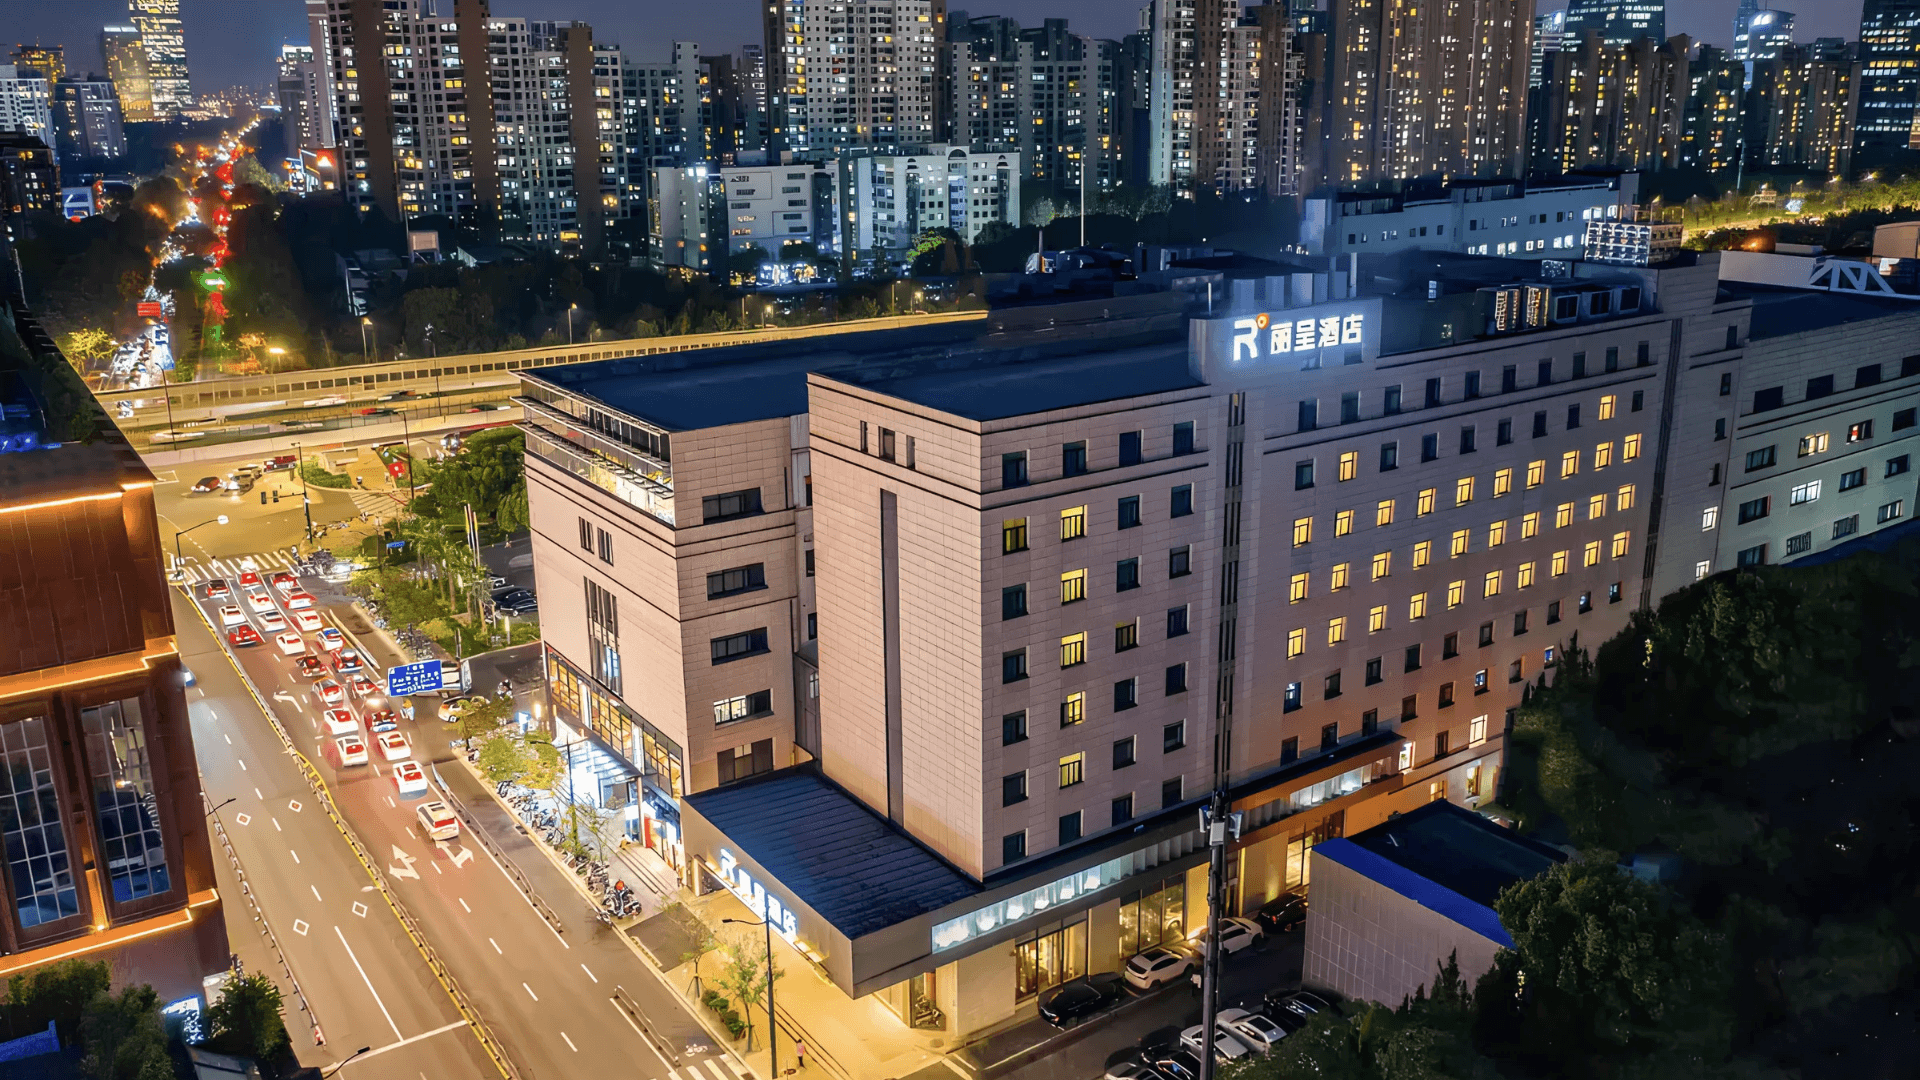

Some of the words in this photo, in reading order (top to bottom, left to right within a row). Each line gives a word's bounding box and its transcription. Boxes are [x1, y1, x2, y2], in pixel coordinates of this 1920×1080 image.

[1233, 318, 1259, 361] R
[1270, 313, 1364, 355] 丽呈酒店
